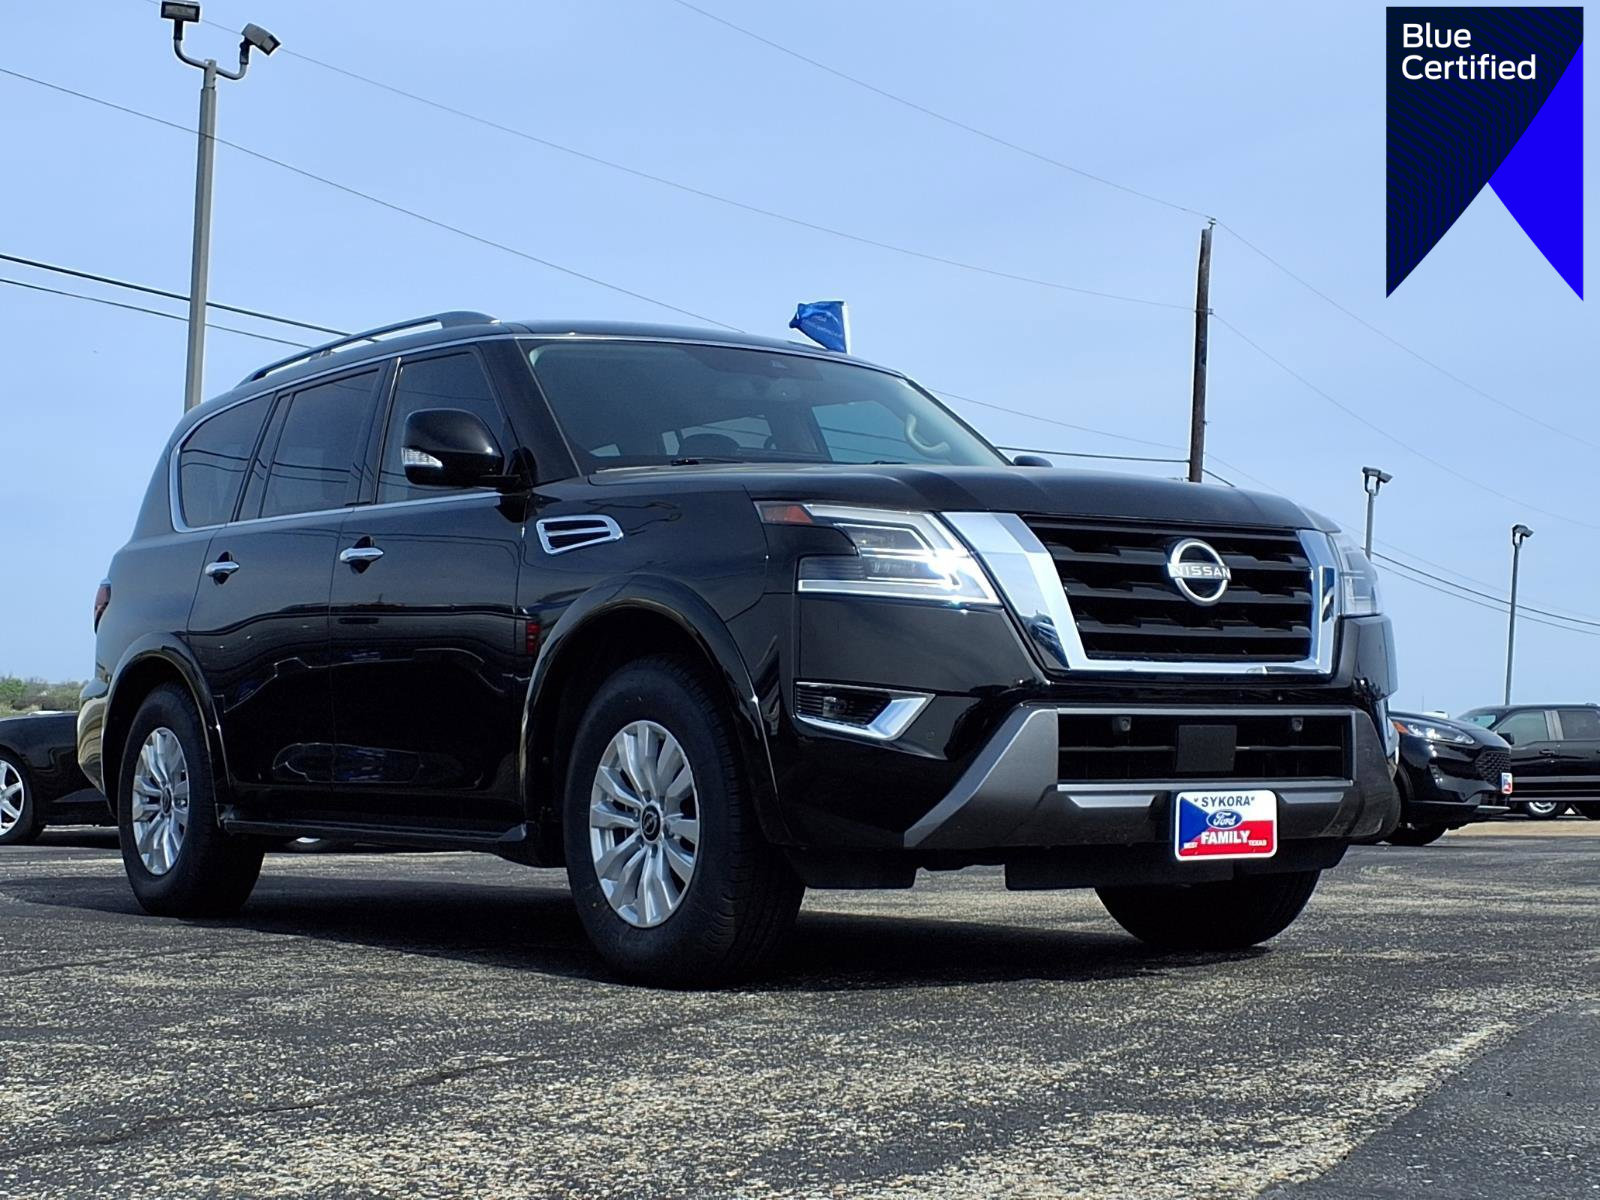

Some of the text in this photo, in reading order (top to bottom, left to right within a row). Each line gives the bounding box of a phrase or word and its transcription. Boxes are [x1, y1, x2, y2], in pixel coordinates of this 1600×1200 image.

[1172, 565, 1231, 579] NISSAN
[1201, 796, 1251, 808] SYKORA
[1212, 811, 1236, 827] Ford
[1200, 830, 1250, 845] FAMILY
